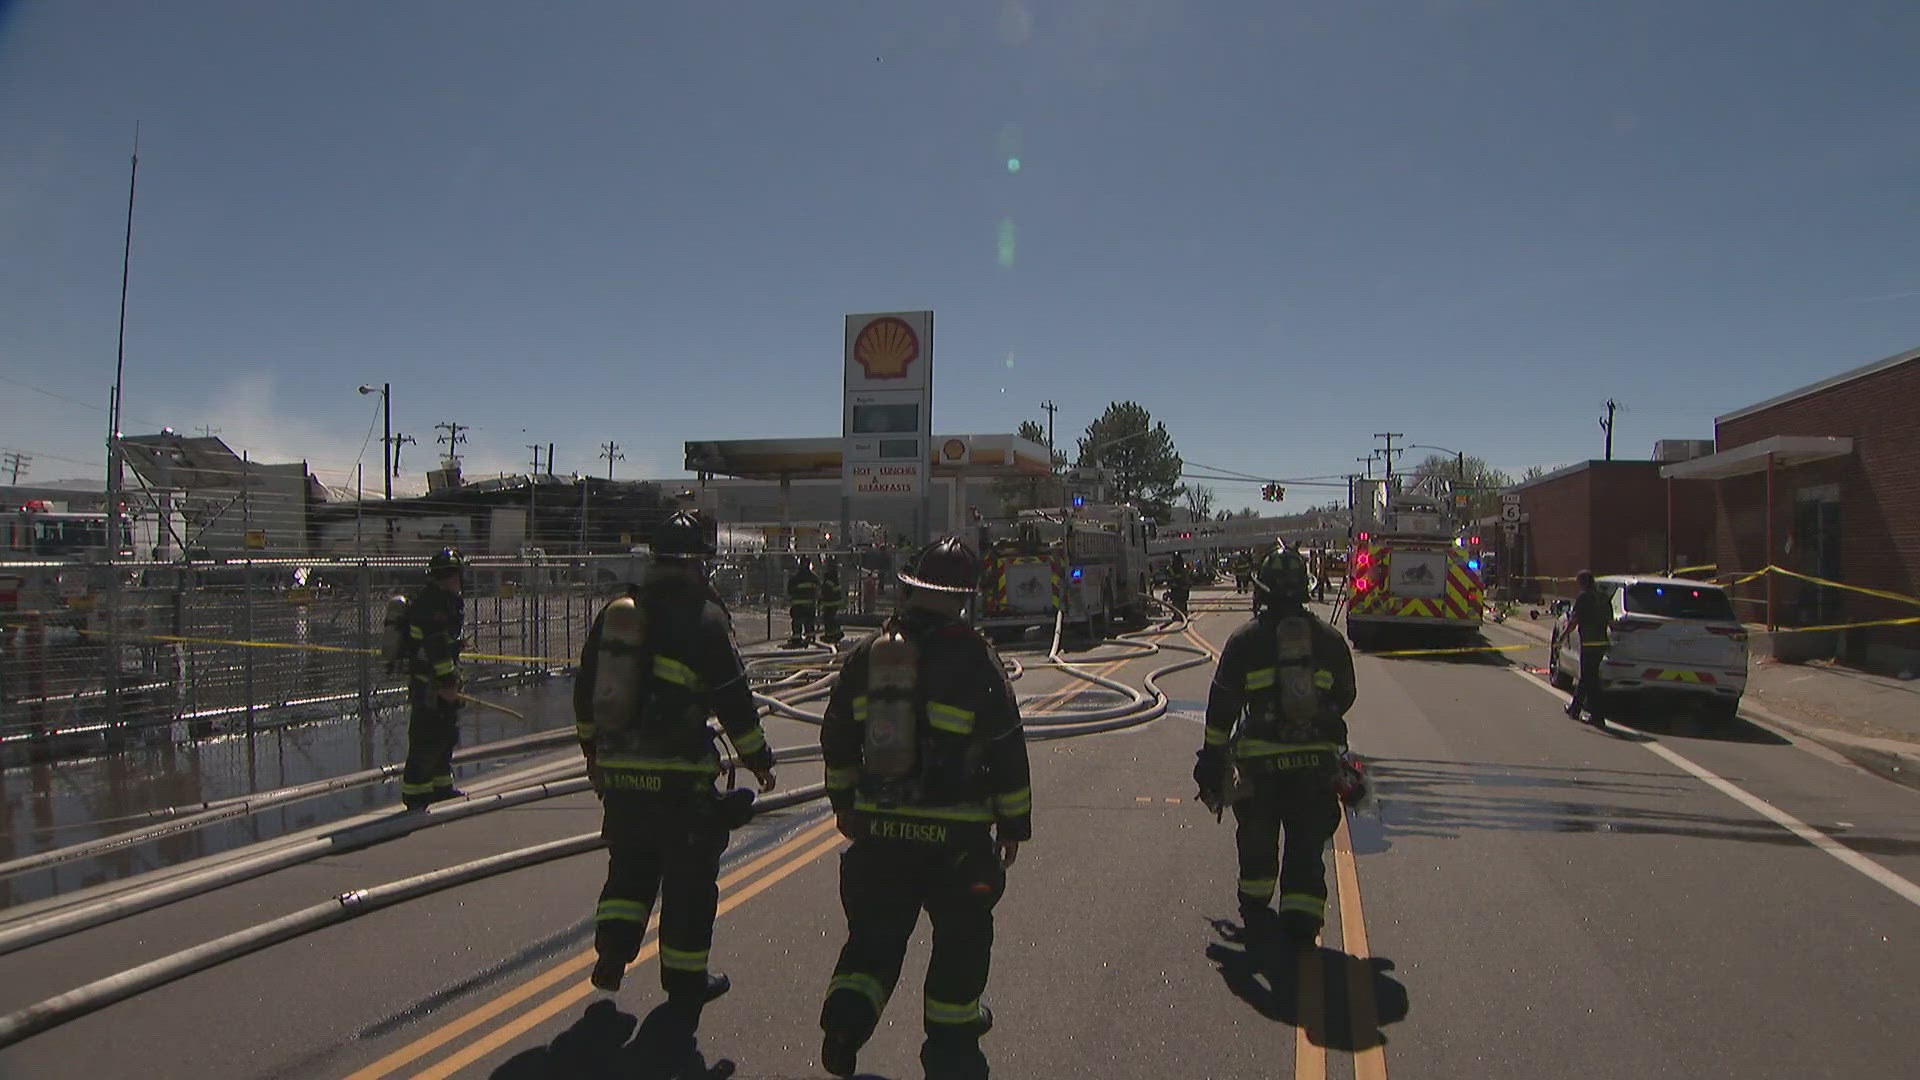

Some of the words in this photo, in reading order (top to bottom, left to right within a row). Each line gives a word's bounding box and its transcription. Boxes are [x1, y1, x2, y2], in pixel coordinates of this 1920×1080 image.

[853, 467, 870, 475] HOT
[880, 467, 917, 475] LUNCHES
[858, 484, 911, 492] BREAKFASTS
[1507, 507, 1515, 518] 6
[883, 821, 946, 842] PETERSEN
